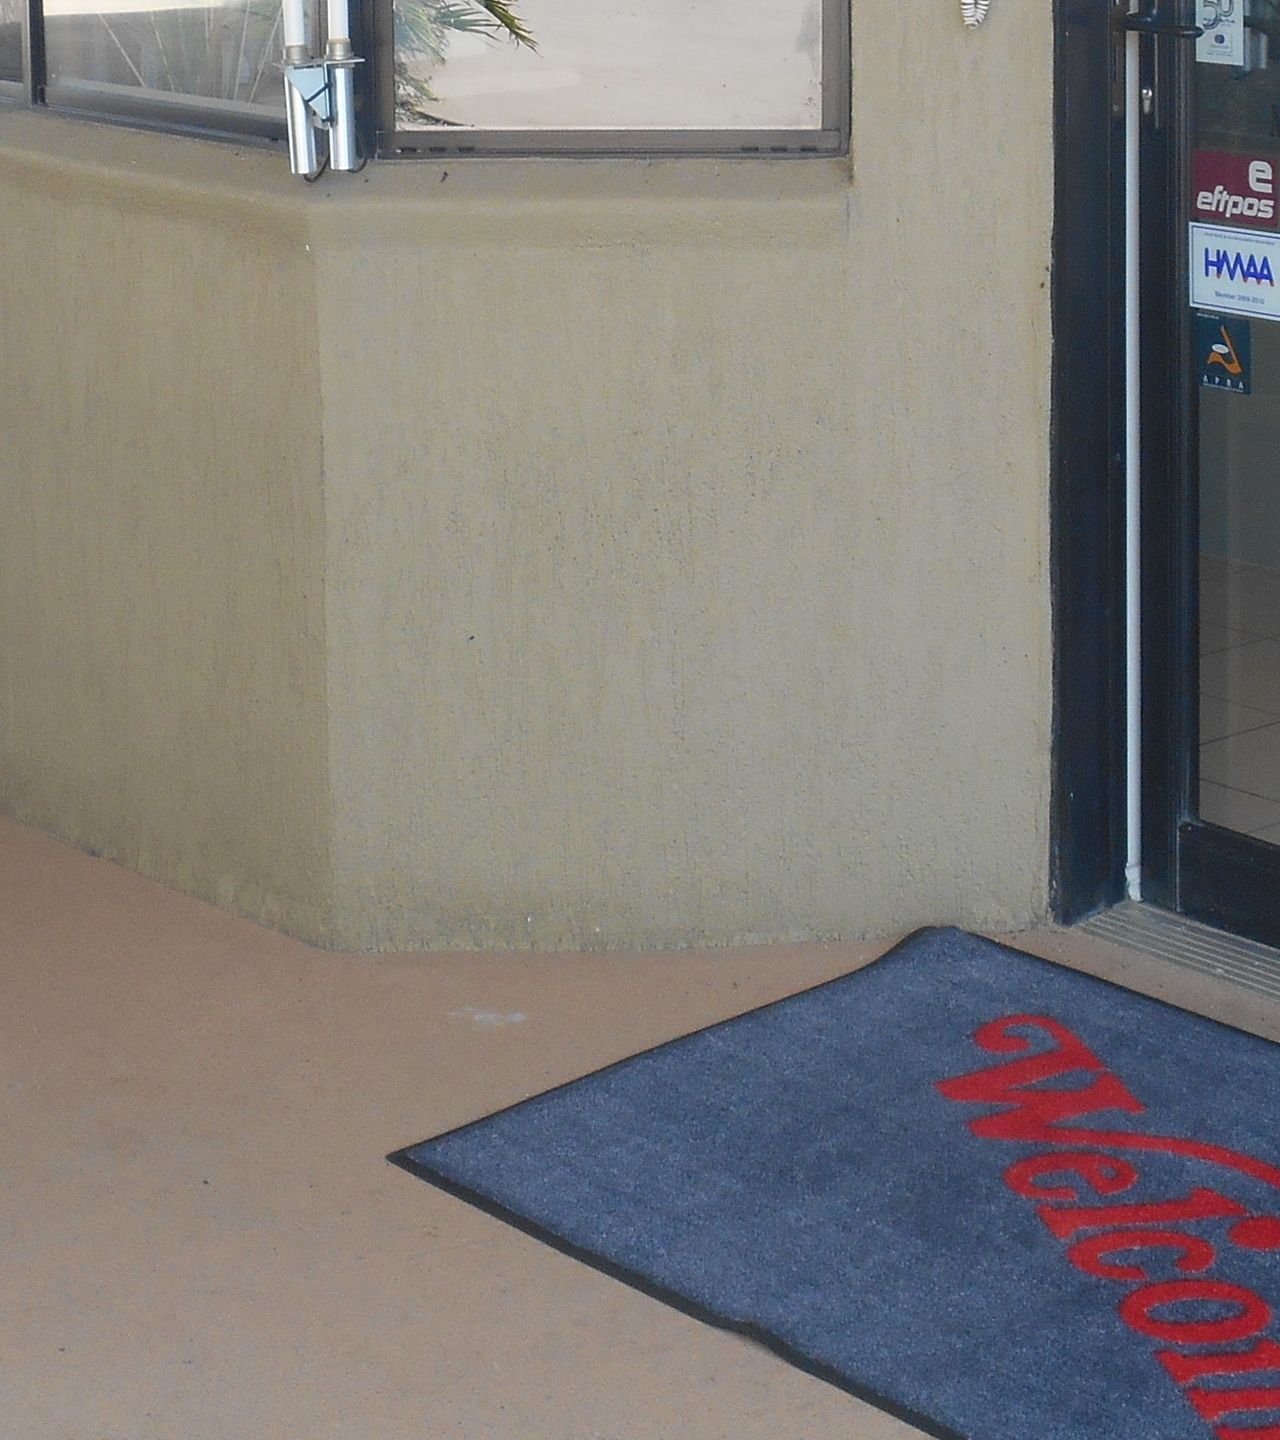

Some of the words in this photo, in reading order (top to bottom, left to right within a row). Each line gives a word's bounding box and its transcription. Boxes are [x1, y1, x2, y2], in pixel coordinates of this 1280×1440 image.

[1248, 159, 1273, 194] e
[1195, 185, 1275, 219] eftpos
[1203, 246, 1276, 288] HMAA
